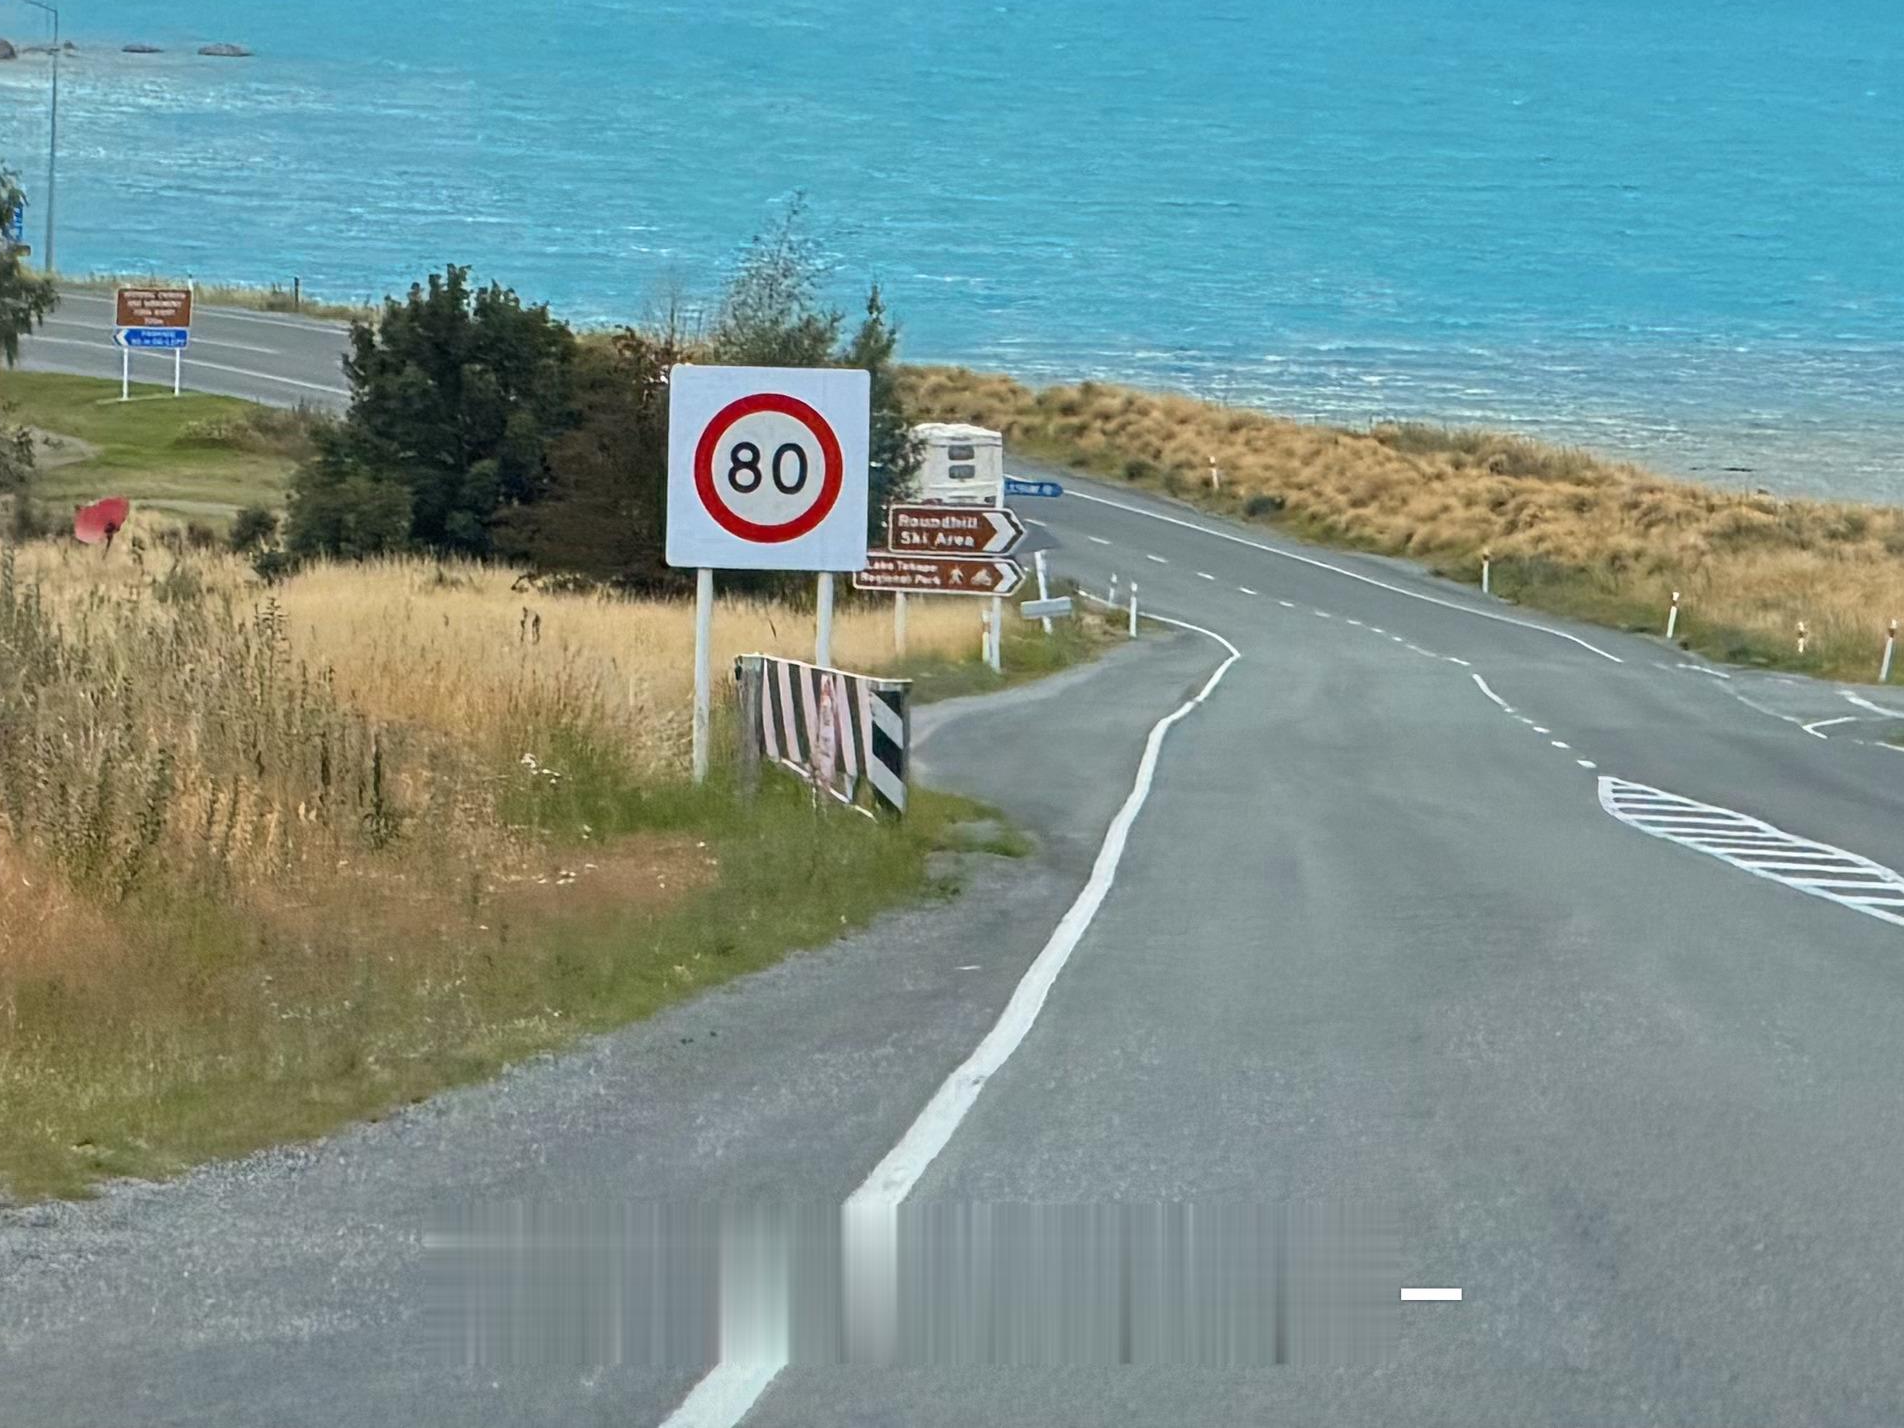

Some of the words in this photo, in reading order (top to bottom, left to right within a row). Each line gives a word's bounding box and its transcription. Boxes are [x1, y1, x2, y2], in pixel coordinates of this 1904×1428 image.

[728, 441, 808, 495] 80
[900, 530, 928, 544] Ski
[935, 531, 975, 547] Area
